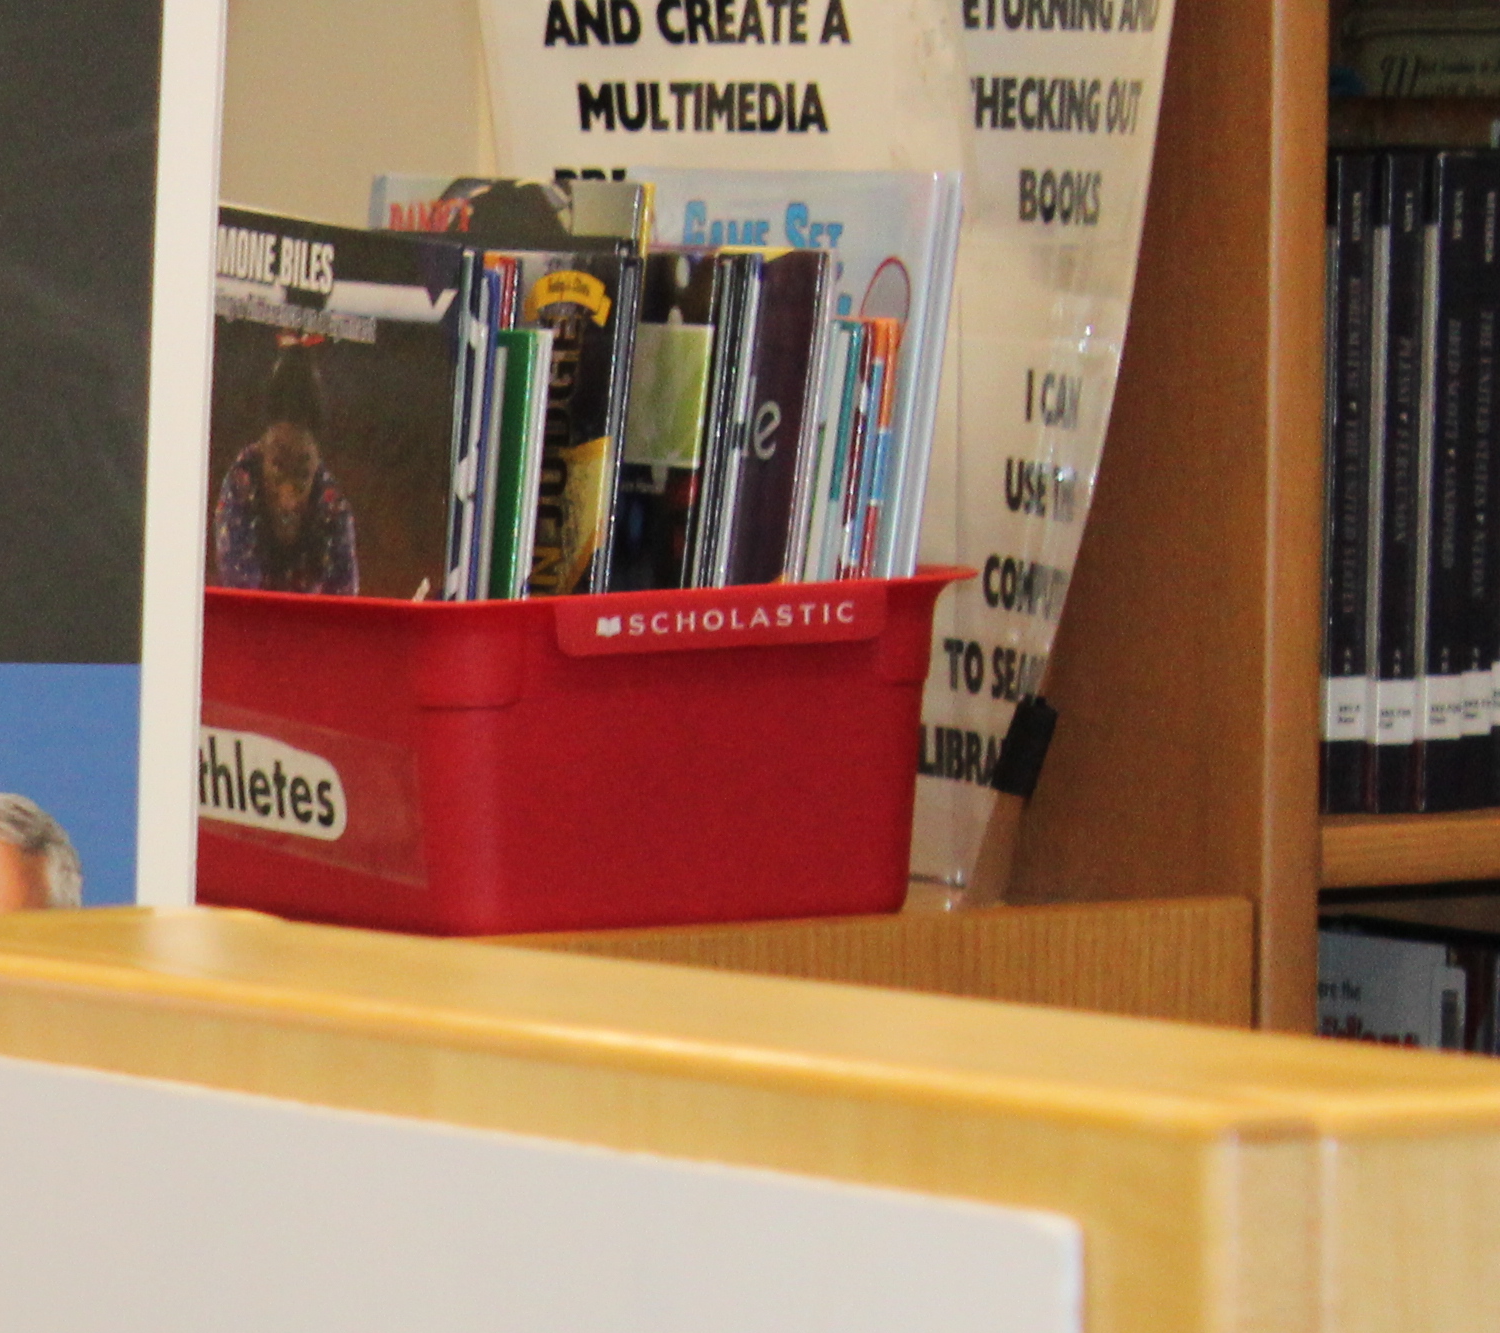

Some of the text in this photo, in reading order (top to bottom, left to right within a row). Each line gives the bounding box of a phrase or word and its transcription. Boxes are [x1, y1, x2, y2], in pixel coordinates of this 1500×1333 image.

[544, 0, 851, 46] AND CREATE A
[577, 82, 829, 133] MULTIMEDIA
[970, 77, 1143, 134] HECKING OUT
[1018, 169, 1101, 226] BOOKS
[278, 234, 335, 295] BILES
[1024, 368, 1082, 431] I CAN
[1005, 456, 1047, 518] USE
[629, 601, 855, 636] SCHOLASTIC
[943, 638, 984, 696] TO
